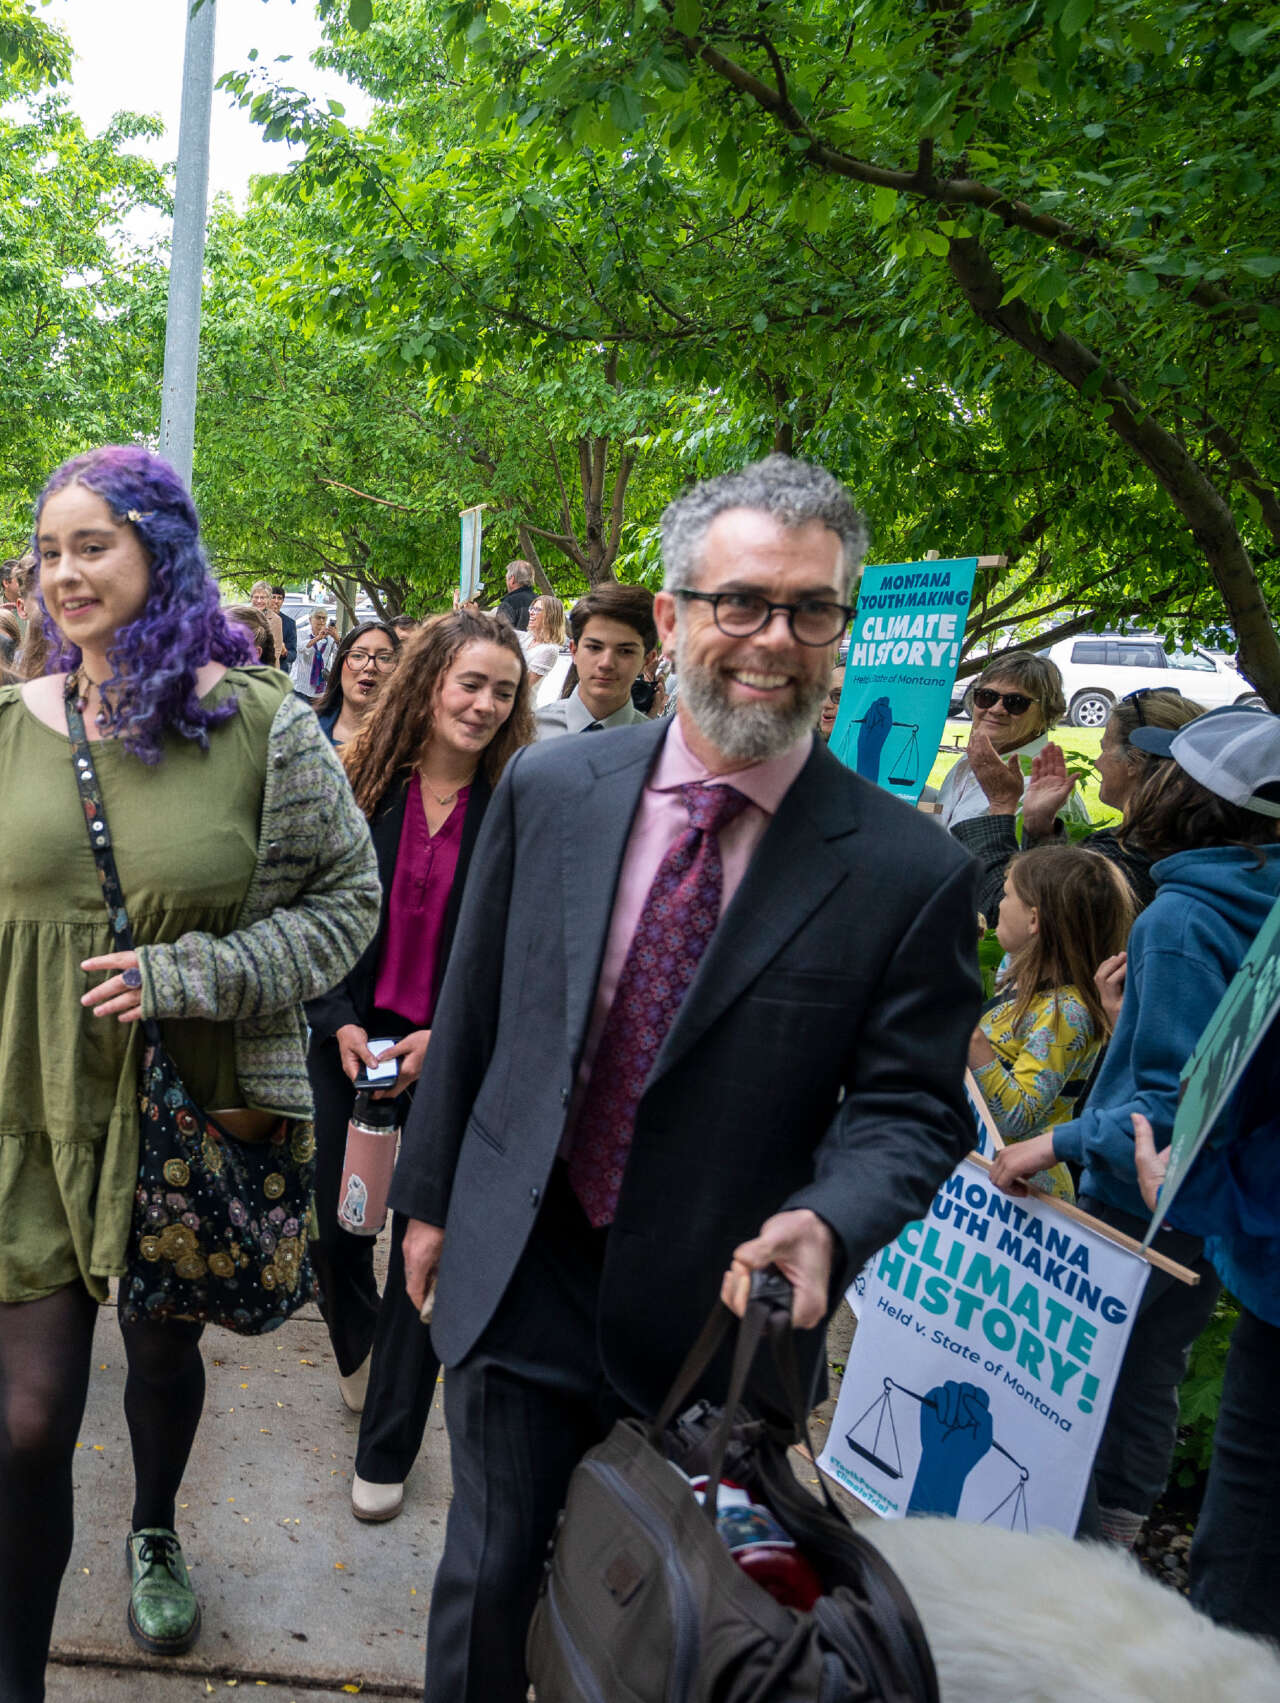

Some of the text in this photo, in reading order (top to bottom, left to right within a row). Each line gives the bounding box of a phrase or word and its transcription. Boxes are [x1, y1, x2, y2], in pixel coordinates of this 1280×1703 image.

[862, 614, 957, 640] CLIMATE
[880, 572, 951, 590] MONTANA
[851, 641, 959, 668] HISTORY!
[898, 674, 946, 687] Montana
[932, 1194, 1128, 1325] UTH MAKING
[940, 1175, 1089, 1275] MONTANA
[877, 1246, 1100, 1414] HISTORY!
[897, 1220, 1098, 1365] CLIMATE
[877, 1296, 1073, 1432] Held v. State of Montana
